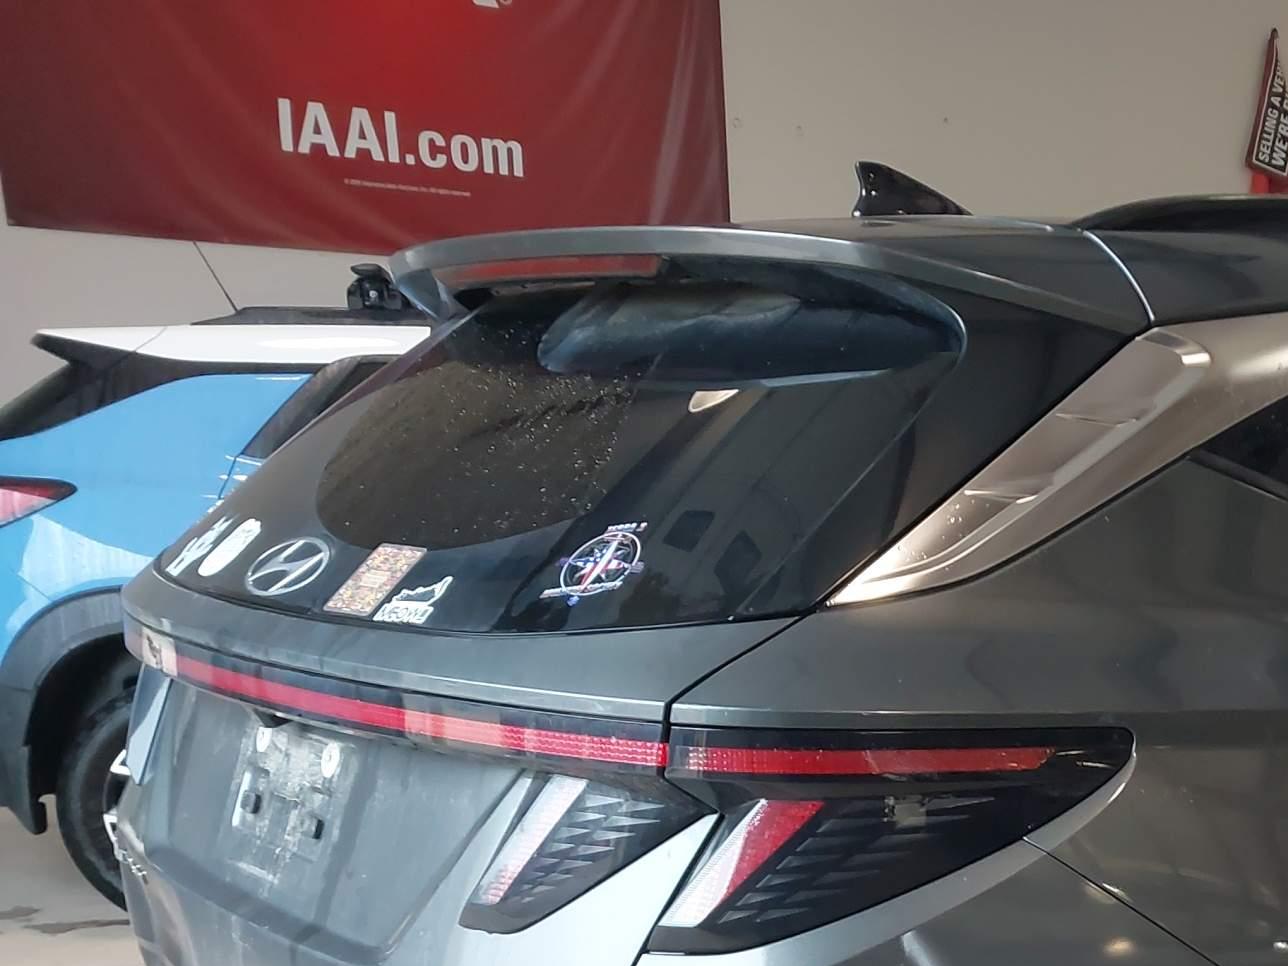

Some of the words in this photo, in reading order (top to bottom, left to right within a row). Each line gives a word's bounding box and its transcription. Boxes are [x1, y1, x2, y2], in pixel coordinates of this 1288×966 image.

[277, 97, 525, 178] IAAI.com
[1258, 108, 1279, 163] SELLING
[1270, 96, 1282, 107] A
